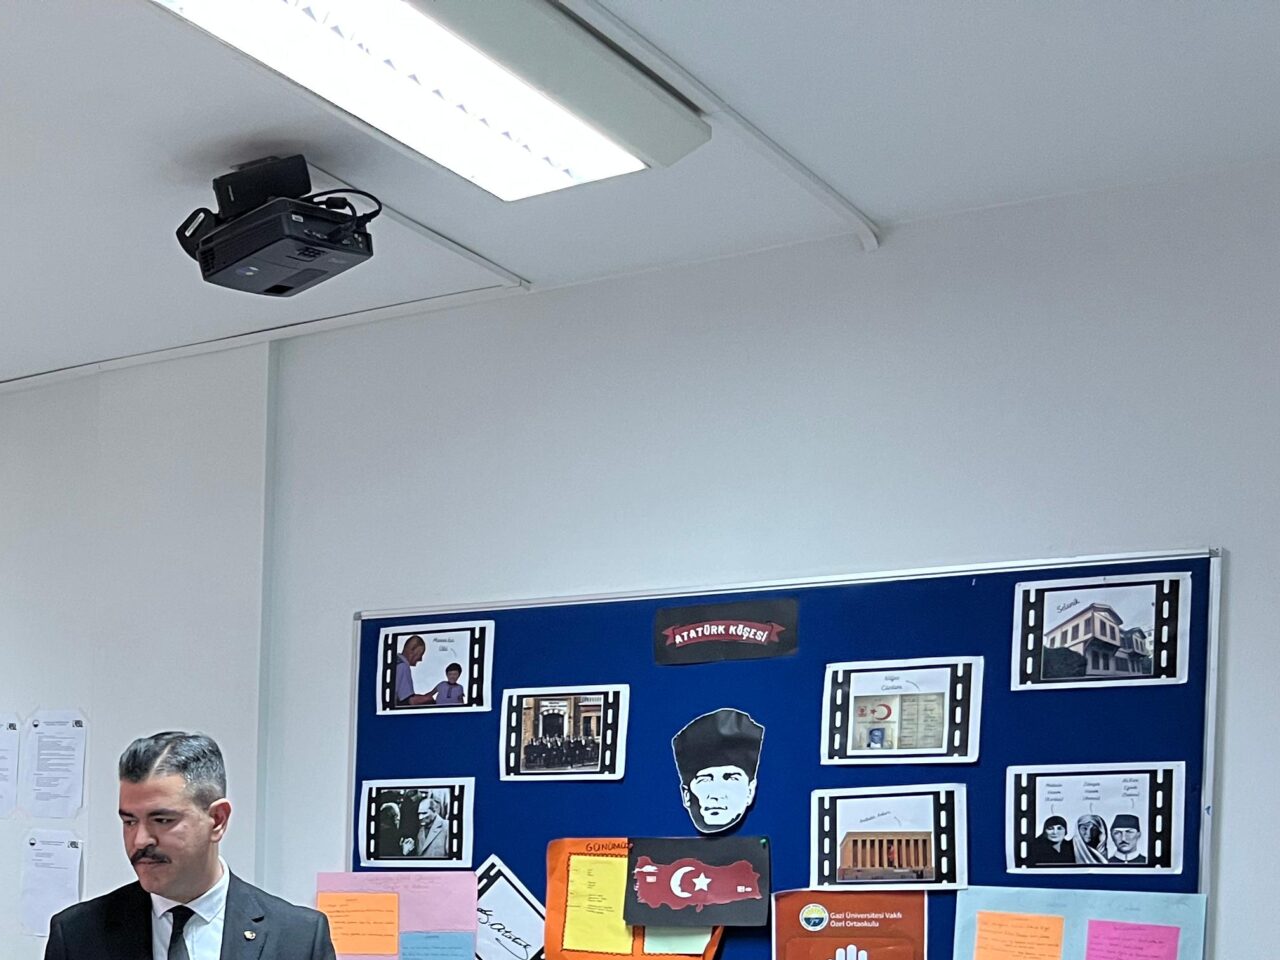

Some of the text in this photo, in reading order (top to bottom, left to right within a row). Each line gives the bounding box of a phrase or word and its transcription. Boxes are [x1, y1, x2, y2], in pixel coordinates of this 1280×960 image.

[674, 624, 769, 645] ATATÜRK KÖŞESİ
[830, 911, 845, 919] Gazi
[845, 911, 885, 919] Üniversitesi
